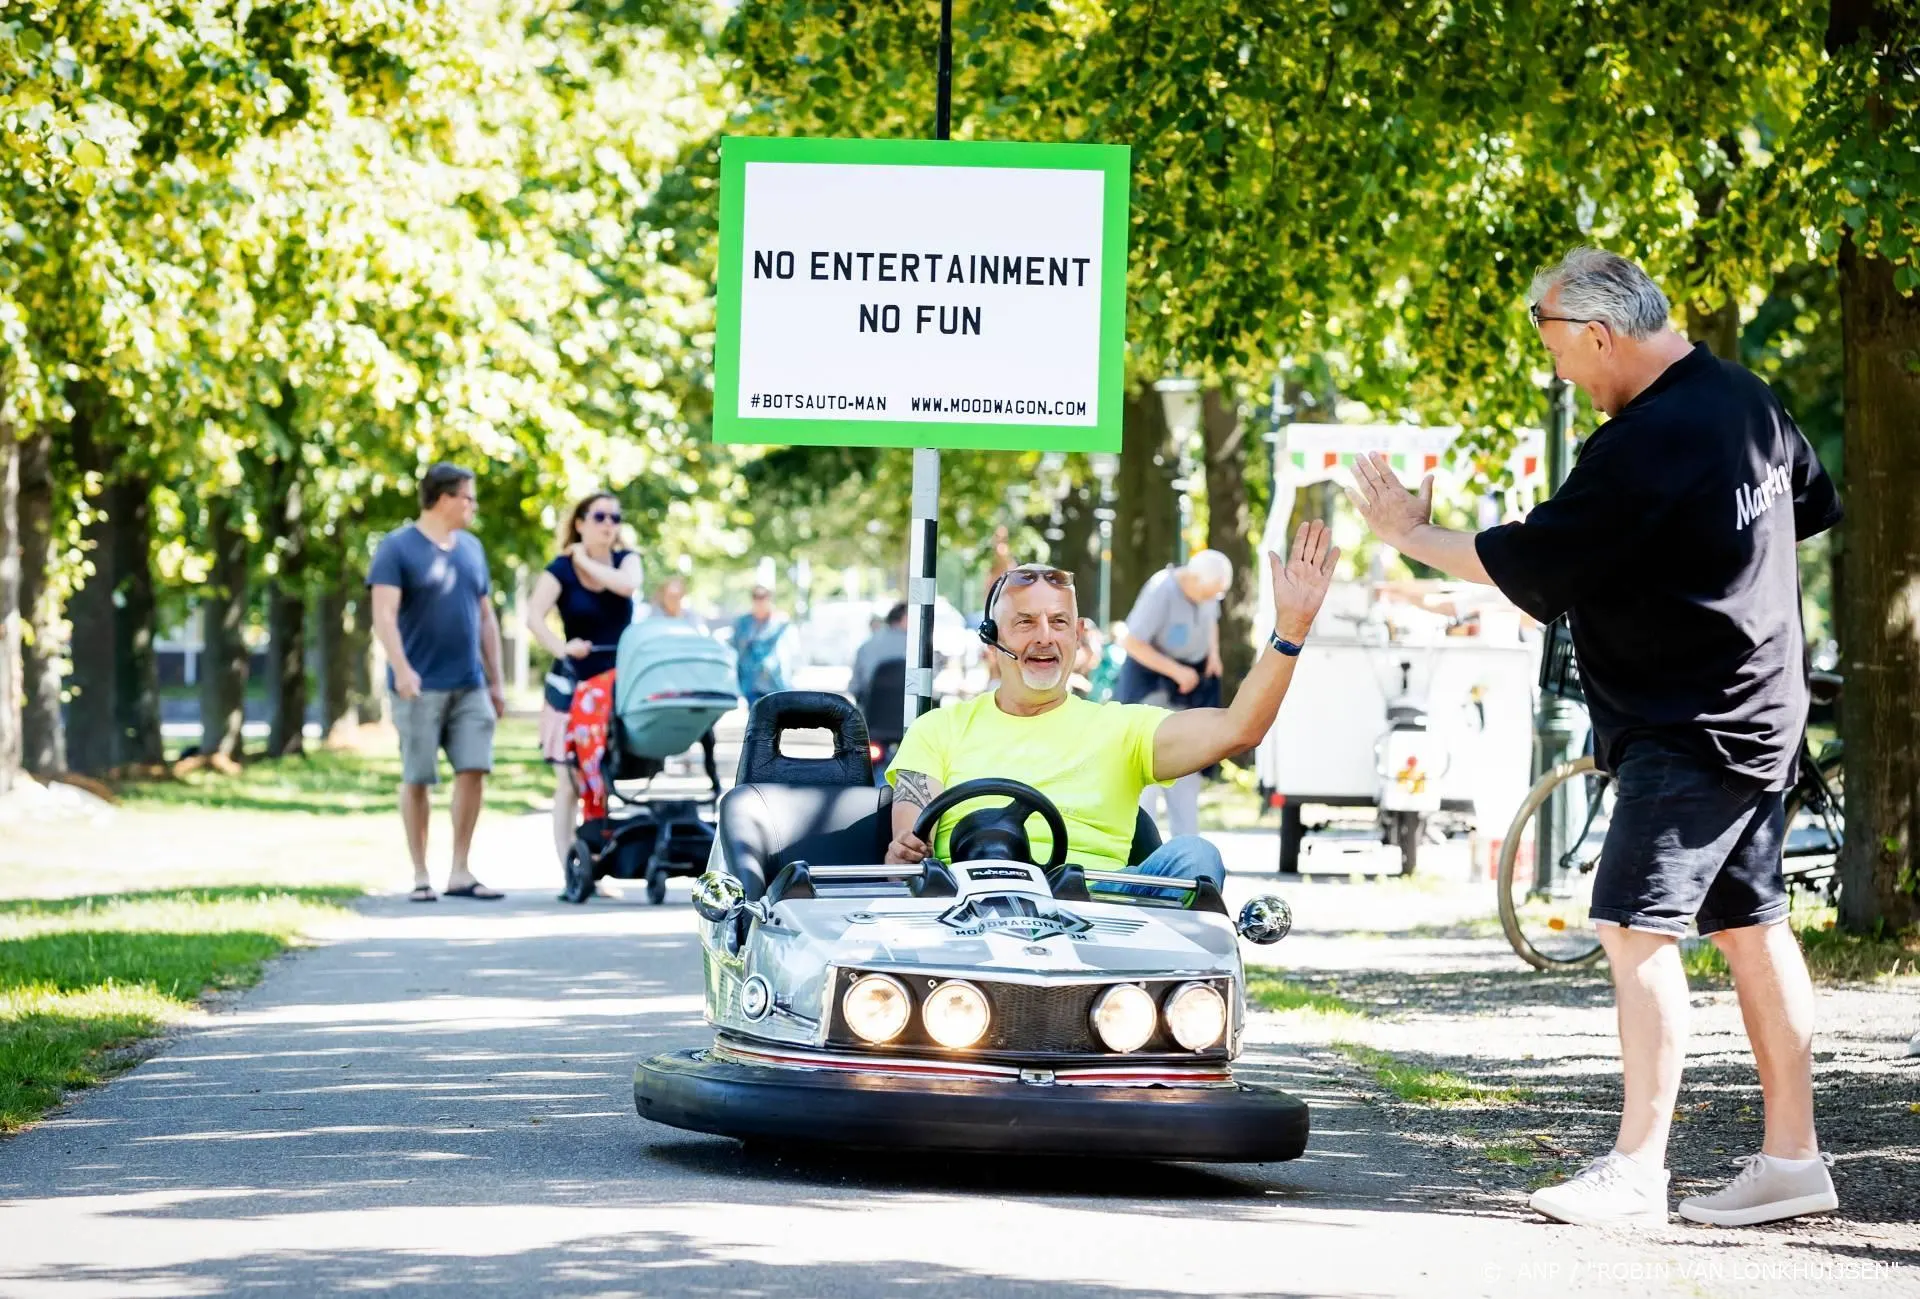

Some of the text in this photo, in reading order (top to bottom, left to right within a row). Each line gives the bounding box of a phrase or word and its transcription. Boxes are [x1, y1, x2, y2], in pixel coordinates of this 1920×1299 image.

[753, 250, 1091, 287] NO ENTERTAINMENT
[859, 303, 981, 336] NO FUN
[750, 393, 1086, 416] #BOTSAUTO-MAN WWW.MOODWAGON.COM
[1735, 463, 1791, 530] Martn
